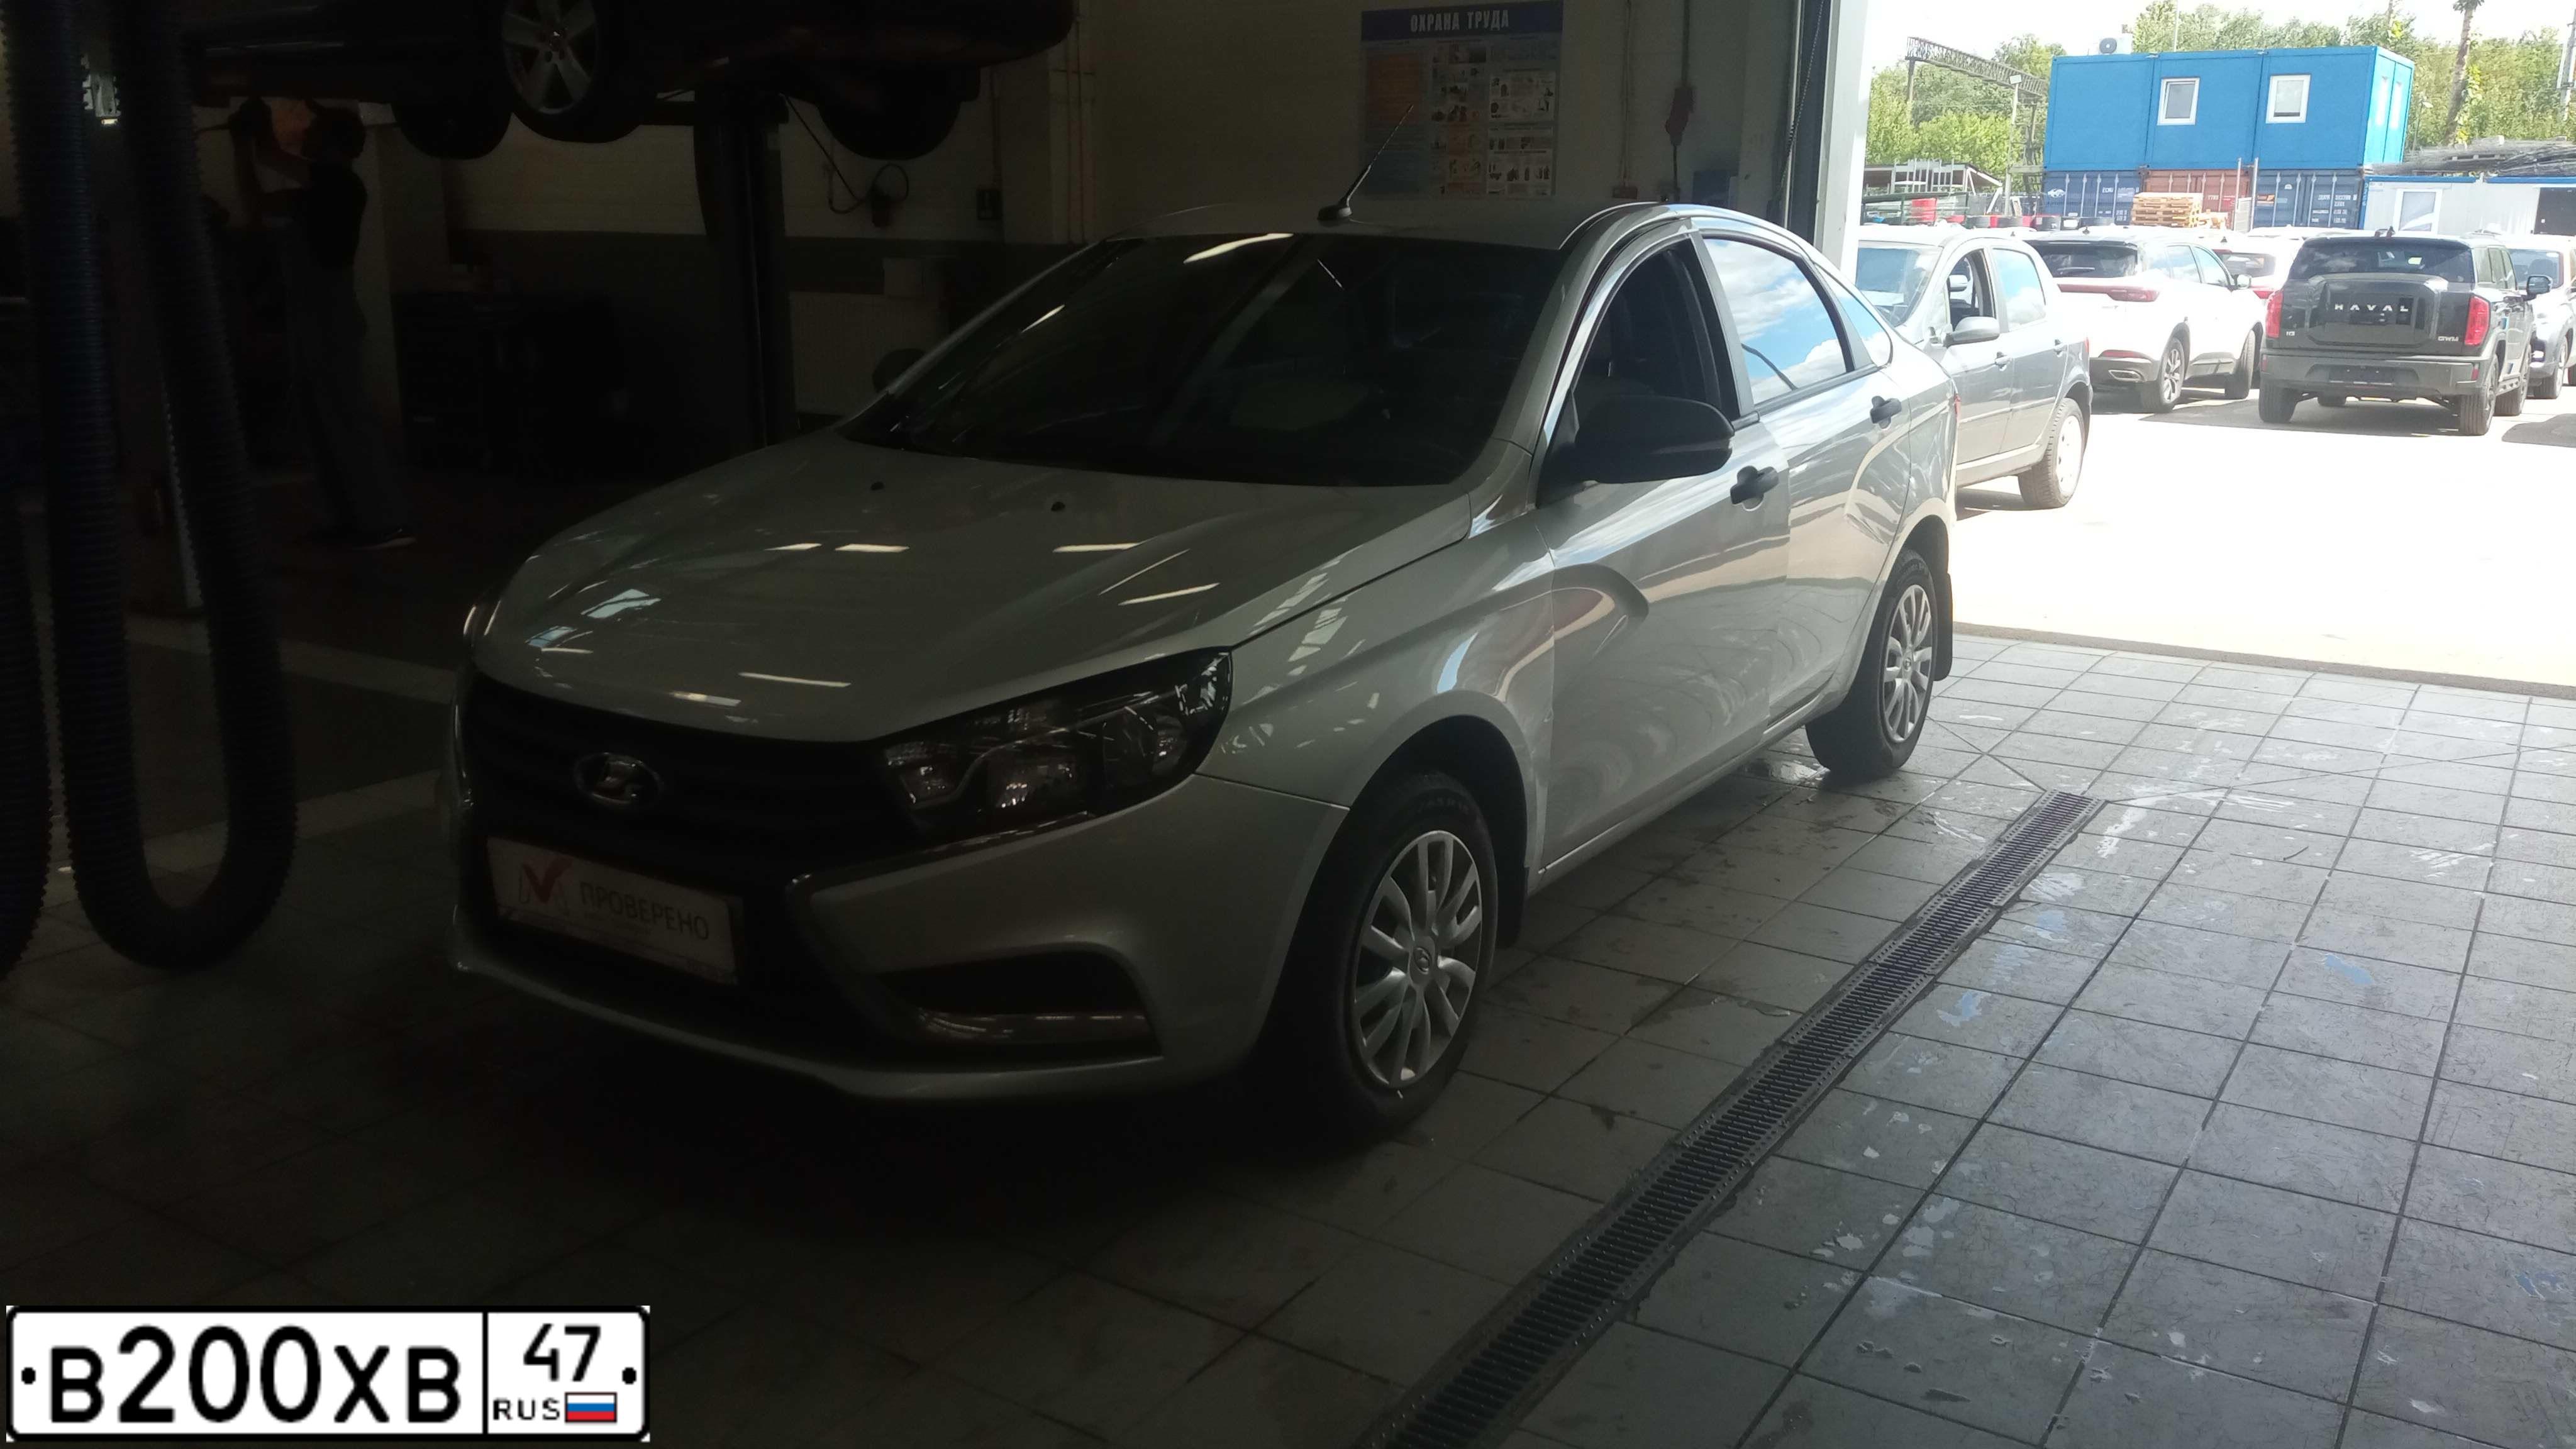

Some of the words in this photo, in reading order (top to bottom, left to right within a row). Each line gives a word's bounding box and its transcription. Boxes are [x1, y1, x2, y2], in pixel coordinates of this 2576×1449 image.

[1410, 12, 1460, 33] ОХРАНА
[1467, 9, 1509, 31] ТРУДА
[2334, 304, 2409, 312] HAVAL
[579, 881, 709, 941] ПРОВЕРЕНО
